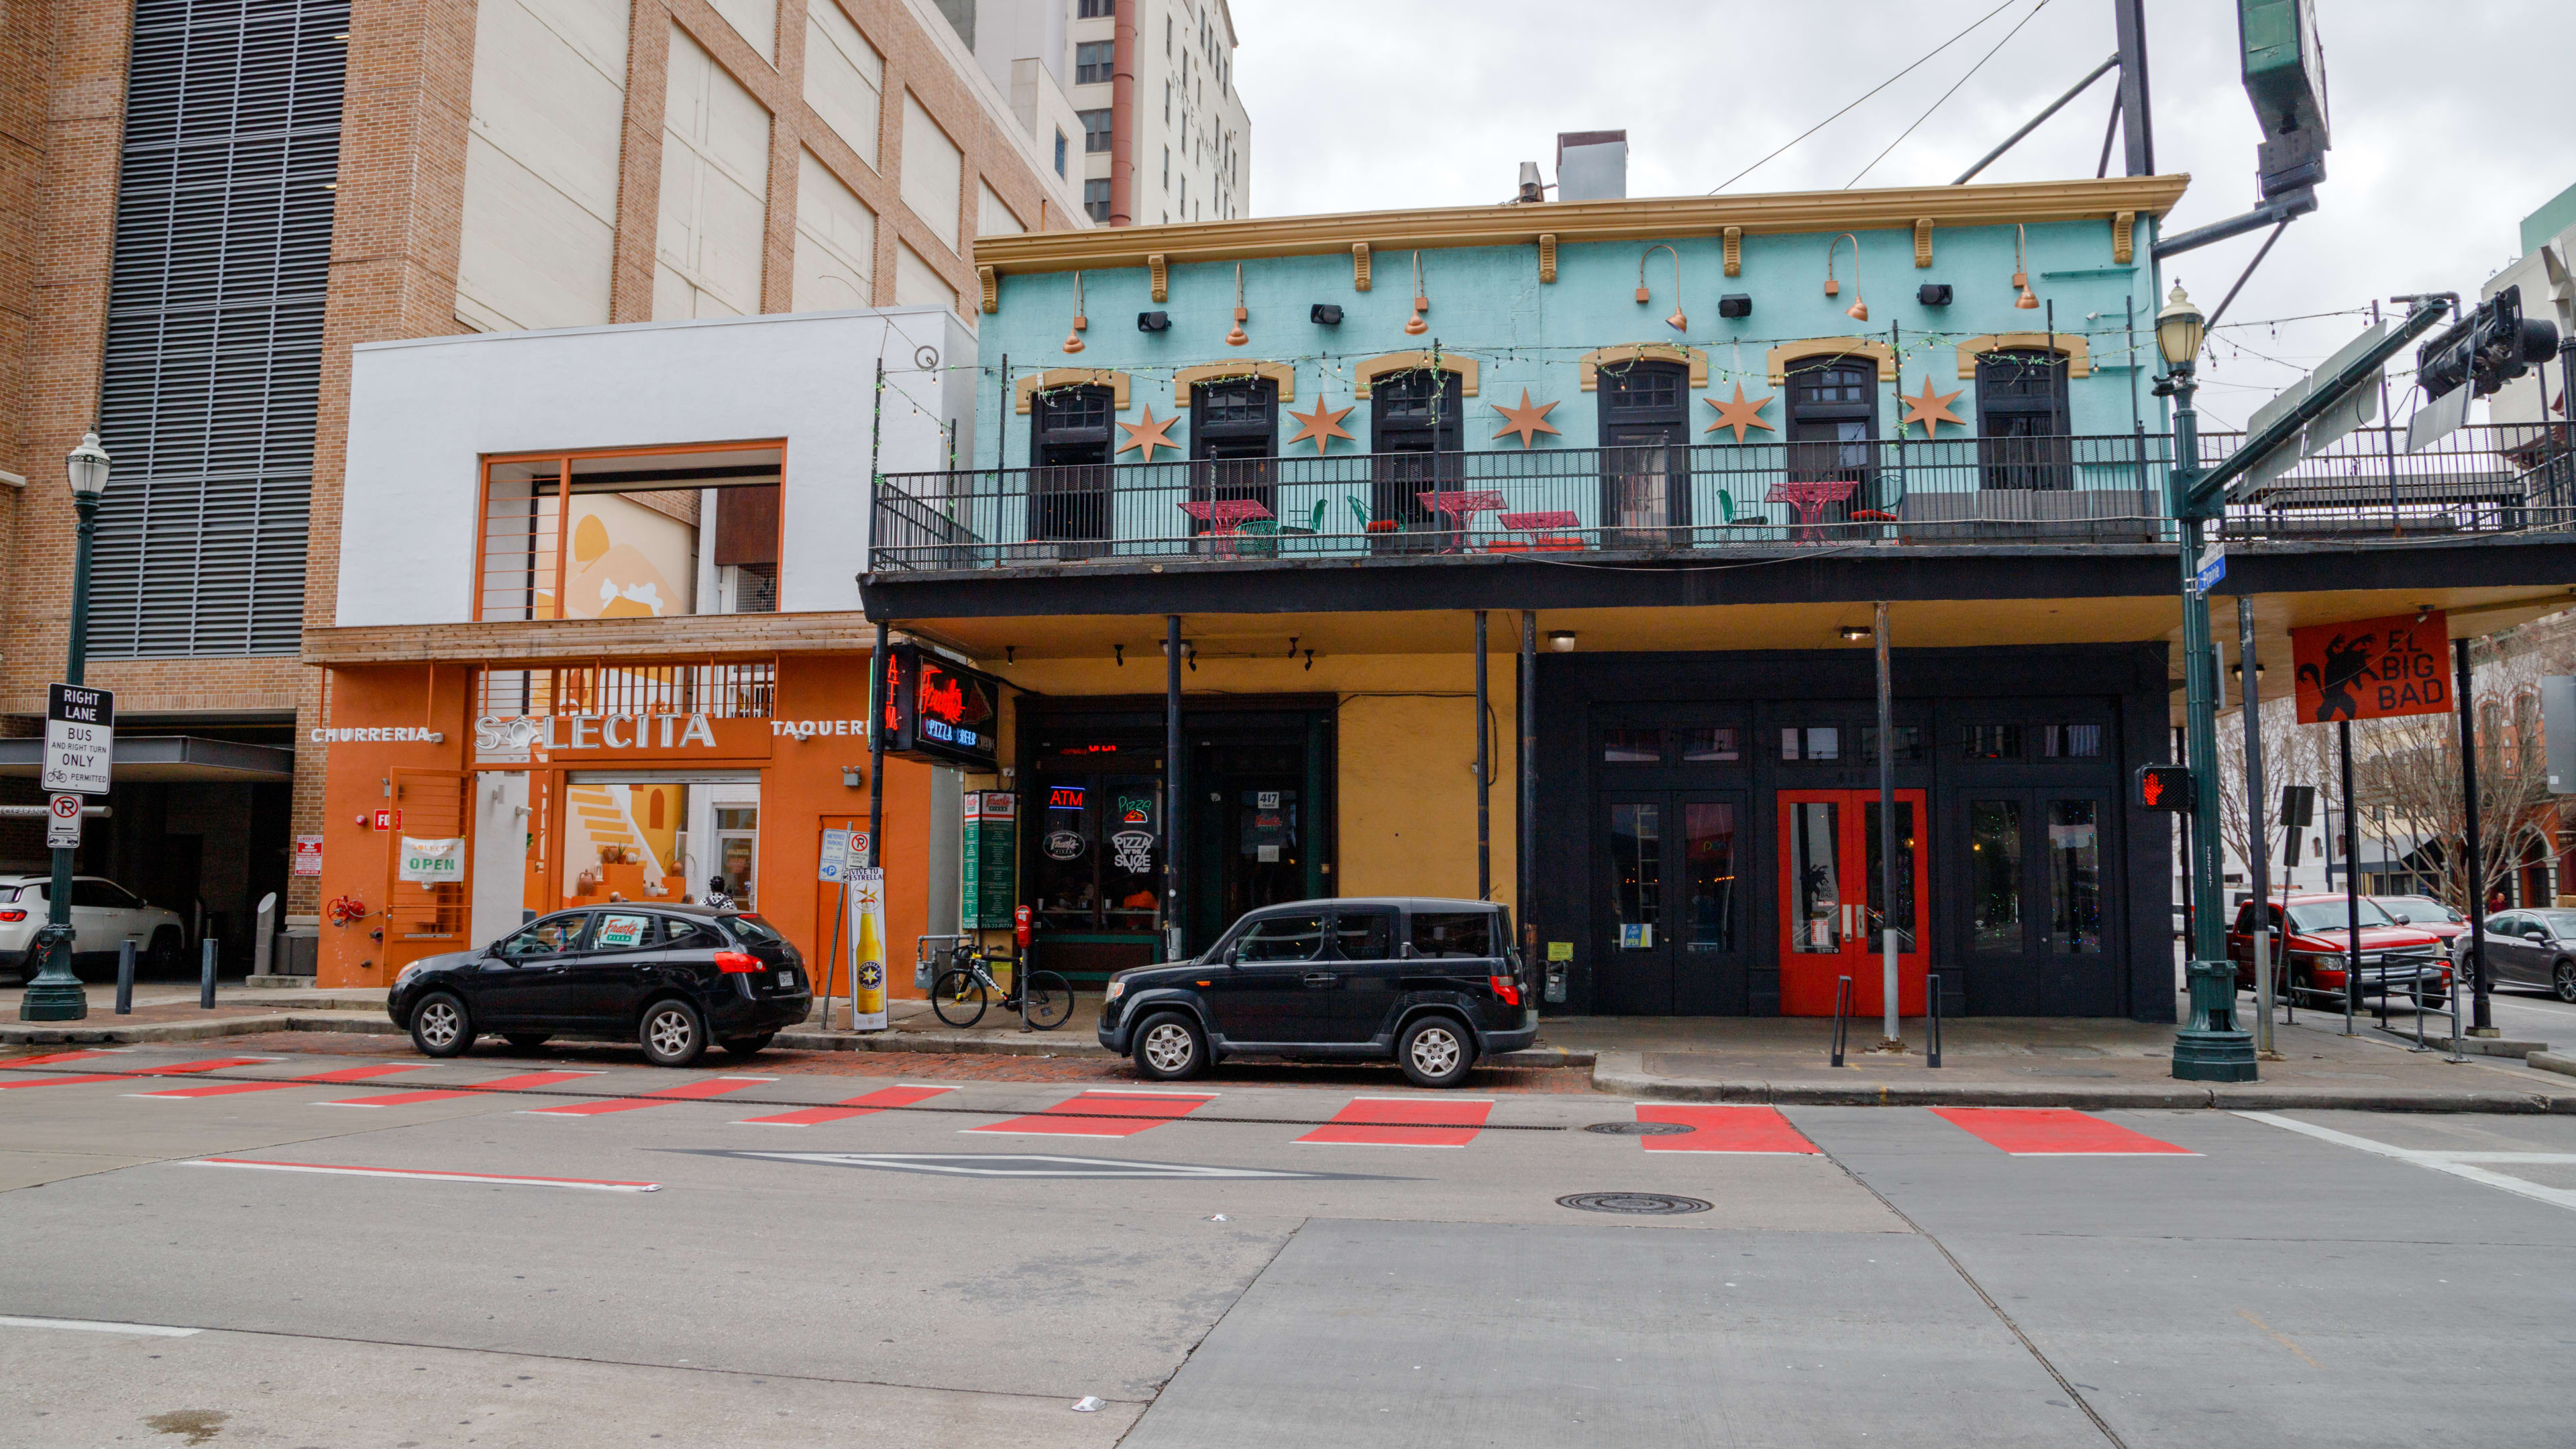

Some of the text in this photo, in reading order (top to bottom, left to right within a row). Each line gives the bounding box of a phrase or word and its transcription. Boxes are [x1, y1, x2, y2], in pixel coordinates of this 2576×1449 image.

[2203, 564, 2219, 586] Prairie
[2388, 630, 2422, 652] EL
[2382, 653, 2434, 681] BIG
[64, 689, 99, 706] RIGHT
[885, 654, 900, 731] ATM
[2378, 679, 2444, 710] BAD
[65, 705, 97, 721] LANE
[68, 727, 92, 741] BUS
[311, 727, 431, 742] CHURRERIA
[474, 712, 717, 750] SOLECITA
[771, 720, 869, 736] TAQUERI
[67, 743, 87, 752] RIGHT
[89, 745, 107, 754] TURN
[62, 753, 95, 767] ONLY
[71, 773, 107, 783] PERMITTED
[1050, 790, 1083, 806] ATM
[1260, 794, 1277, 803] 417
[378, 814, 398, 826] FD
[1115, 837, 1150, 849] PIZZA
[409, 858, 455, 870] OPEN
[1114, 855, 1151, 866] SLICE
